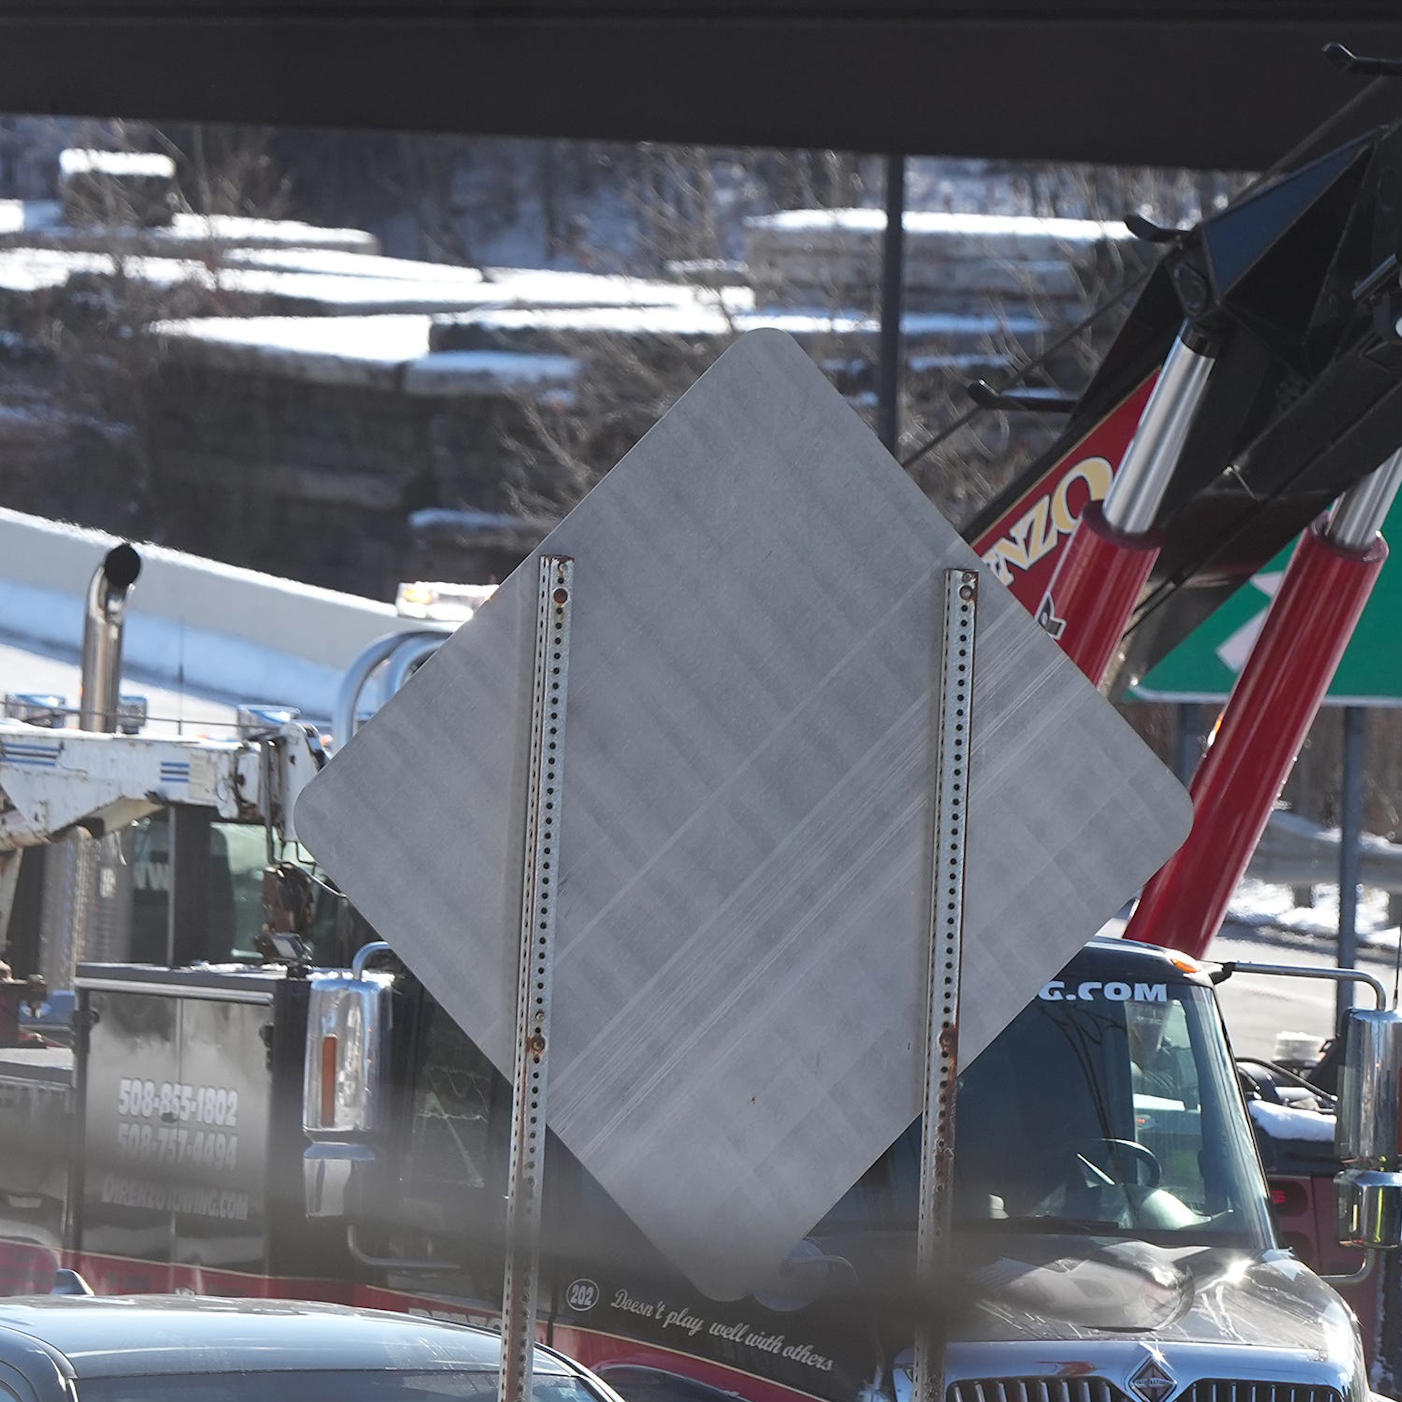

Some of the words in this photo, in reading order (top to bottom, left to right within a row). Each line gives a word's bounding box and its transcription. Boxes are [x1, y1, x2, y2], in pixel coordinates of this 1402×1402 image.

[571, 1284, 595, 1306] 202
[610, 1288, 664, 1320] Doesn't
[662, 1307, 704, 1336] play
[709, 1320, 746, 1342] well
[745, 1331, 785, 1354] with
[782, 1343, 835, 1371] others
